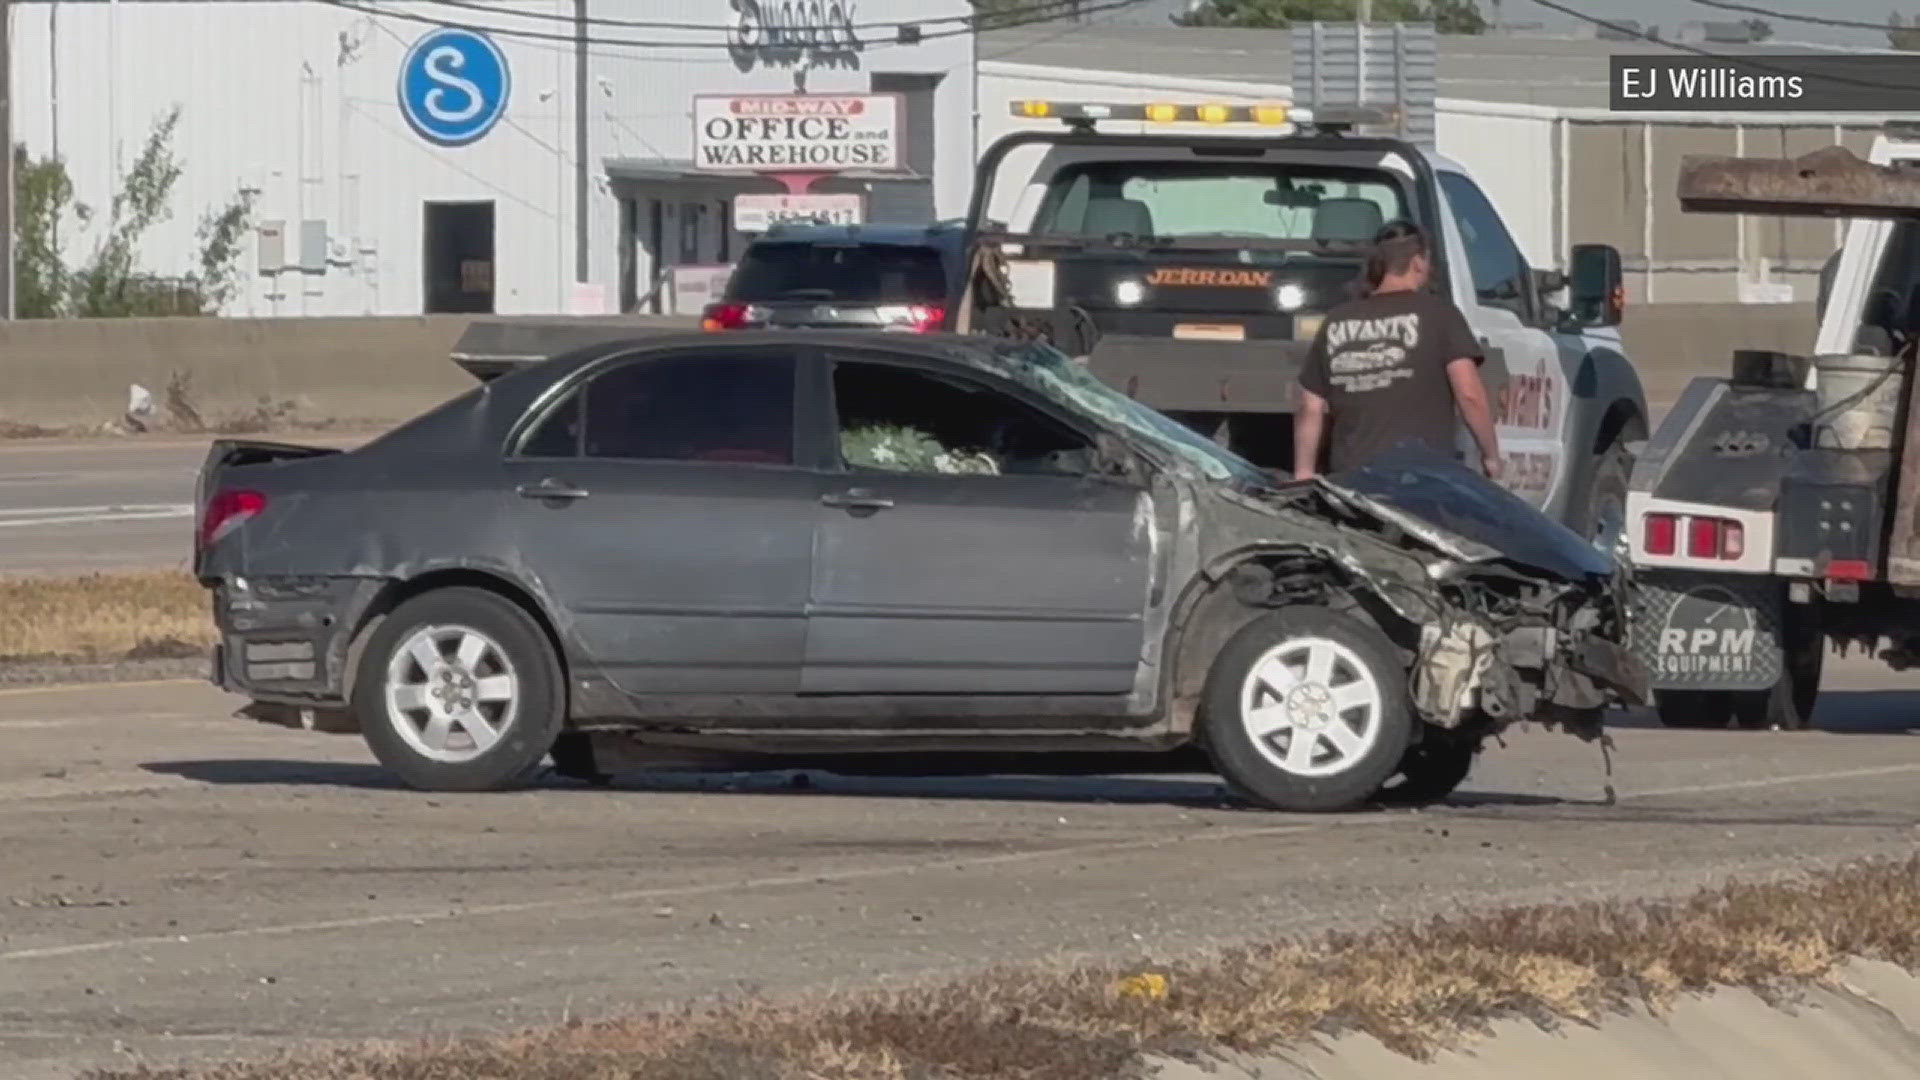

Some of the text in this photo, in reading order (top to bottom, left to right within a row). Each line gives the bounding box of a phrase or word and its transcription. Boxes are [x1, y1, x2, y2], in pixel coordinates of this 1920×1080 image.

[424, 46, 482, 121] S
[705, 117, 889, 140] OFFICE and
[703, 143, 889, 164] WAREHOUSE
[1658, 628, 1755, 654] RPM
[1657, 655, 1752, 673] EQUIPMENT
